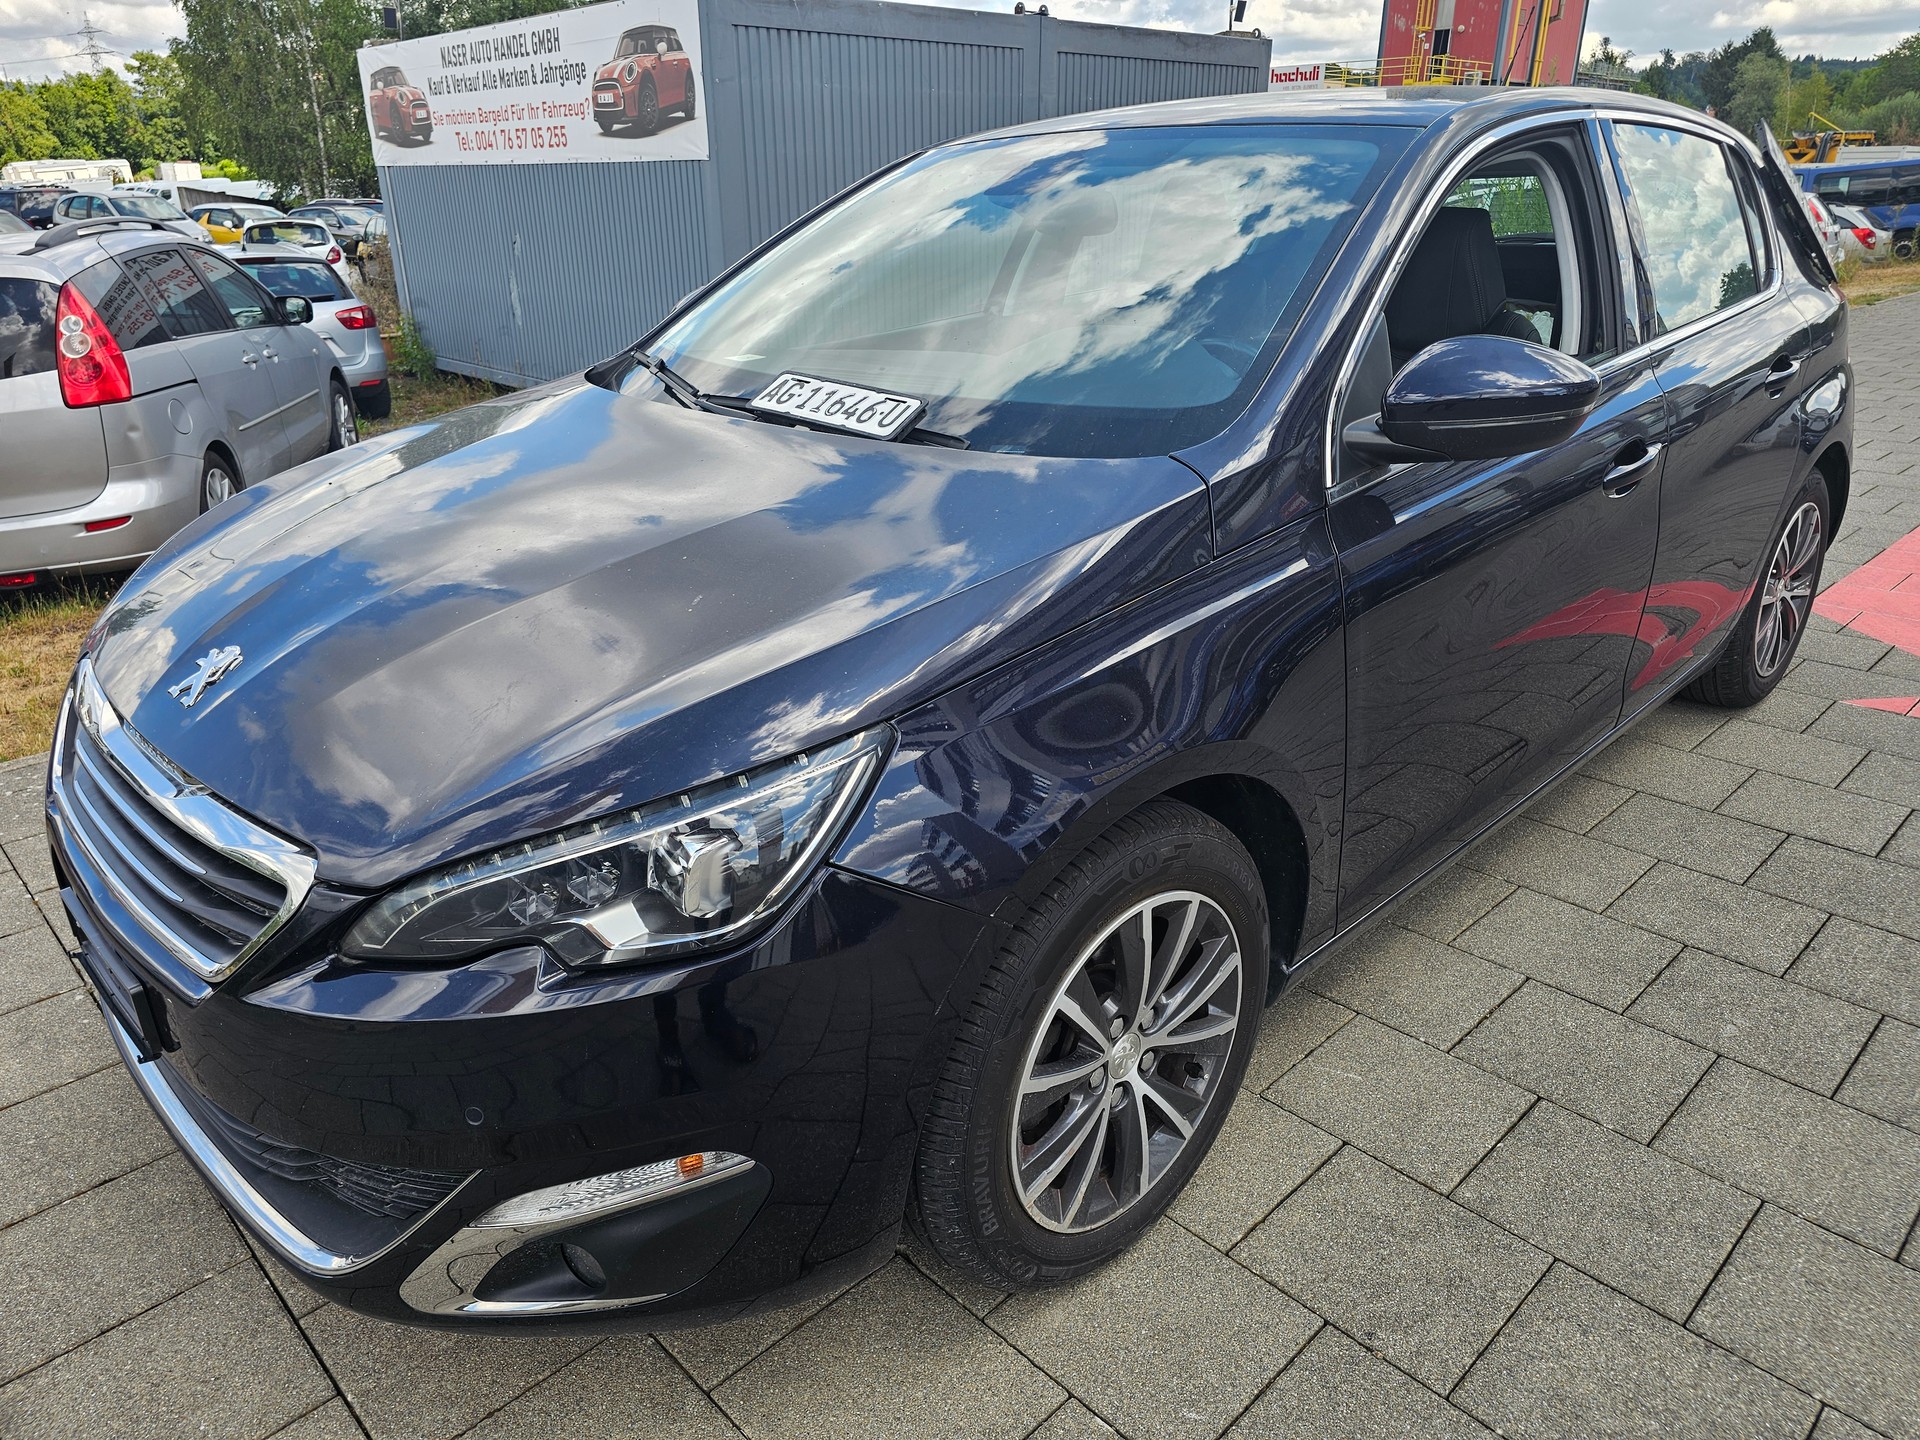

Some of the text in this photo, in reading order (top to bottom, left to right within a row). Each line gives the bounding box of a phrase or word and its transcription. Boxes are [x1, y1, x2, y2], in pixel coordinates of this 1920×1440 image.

[440, 27, 561, 69] NASER AUTO HANDEL GMBH
[427, 59, 587, 96] Kauf & Verkauf Alle Marken & Jahrgänge
[432, 97, 590, 126] Sie möchten Bargeld Für Ihr Fahrzeug?
[455, 126, 568, 151] Tel: 0041 76 57 05 255
